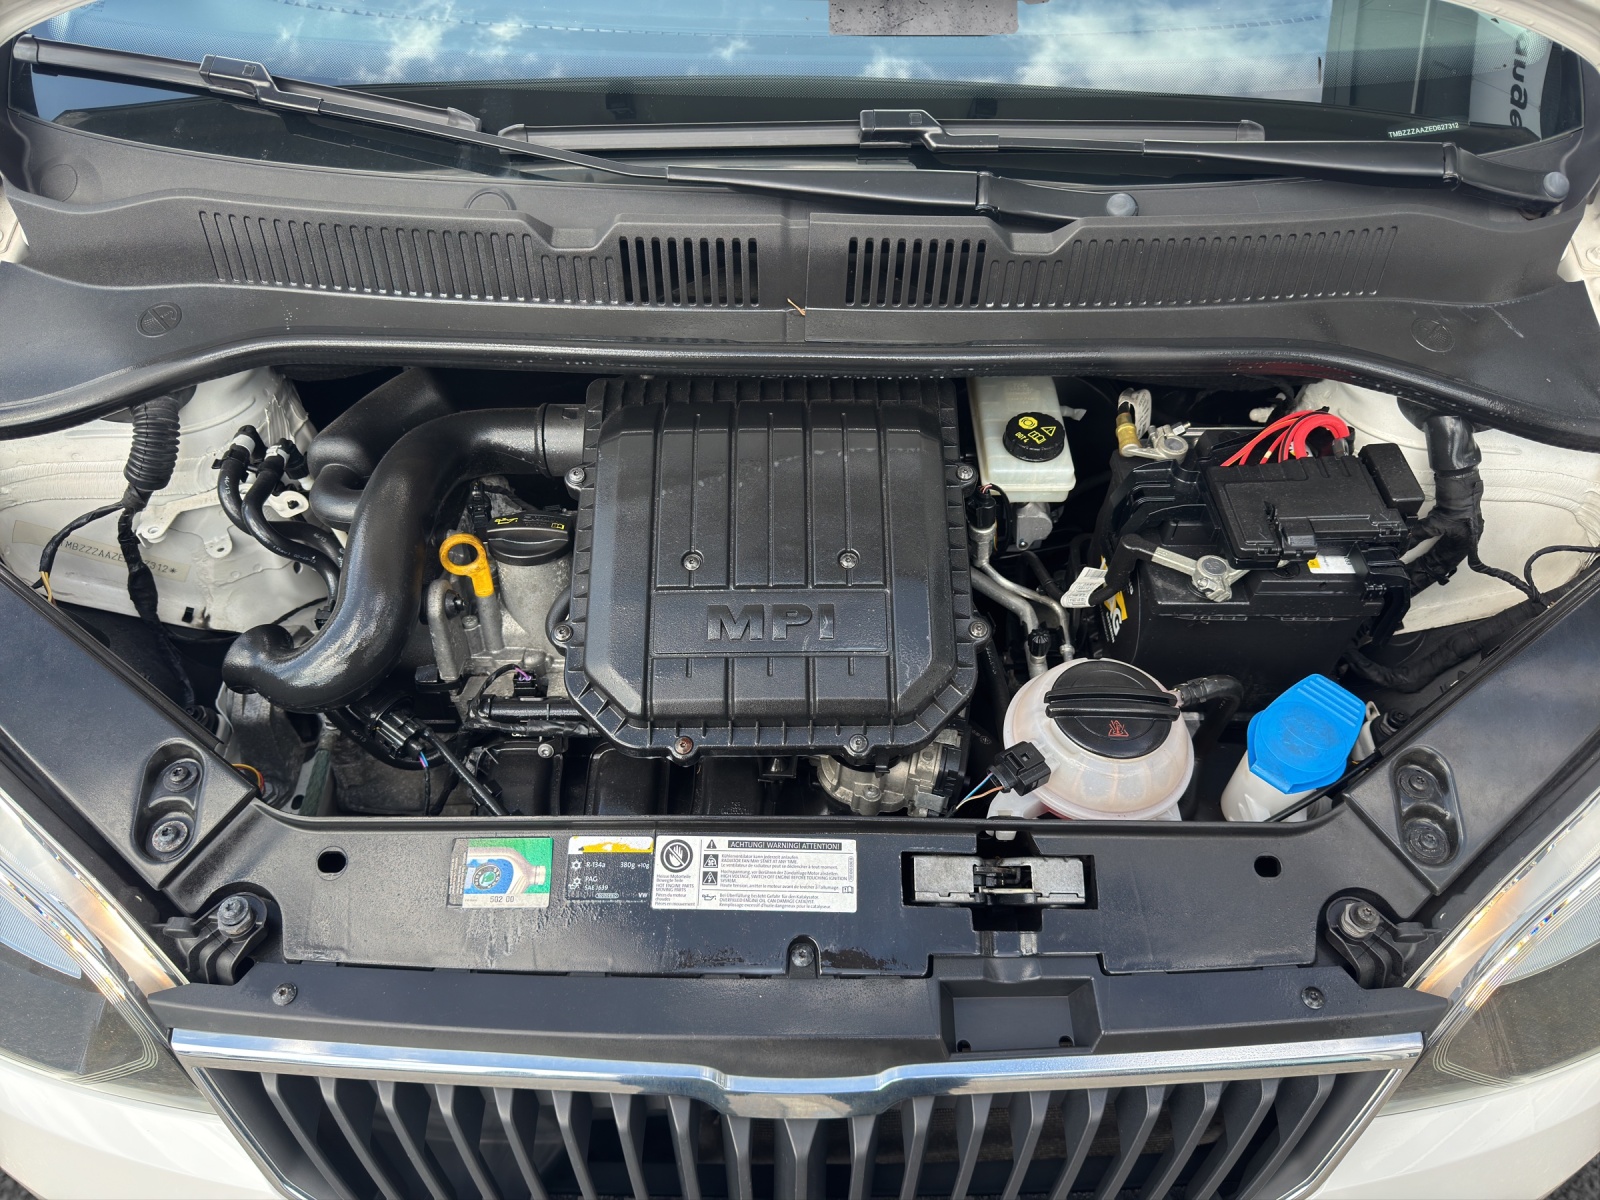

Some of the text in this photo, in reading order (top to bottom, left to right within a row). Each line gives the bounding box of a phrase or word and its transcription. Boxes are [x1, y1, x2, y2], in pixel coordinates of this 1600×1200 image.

[1388, 122, 1459, 138] TMBZZZAAZED627312
[707, 603, 834, 640] MPI
[766, 841, 800, 849] WARNING!
[802, 842, 840, 850] ATTENTION!
[620, 861, 636, 870] 380g
